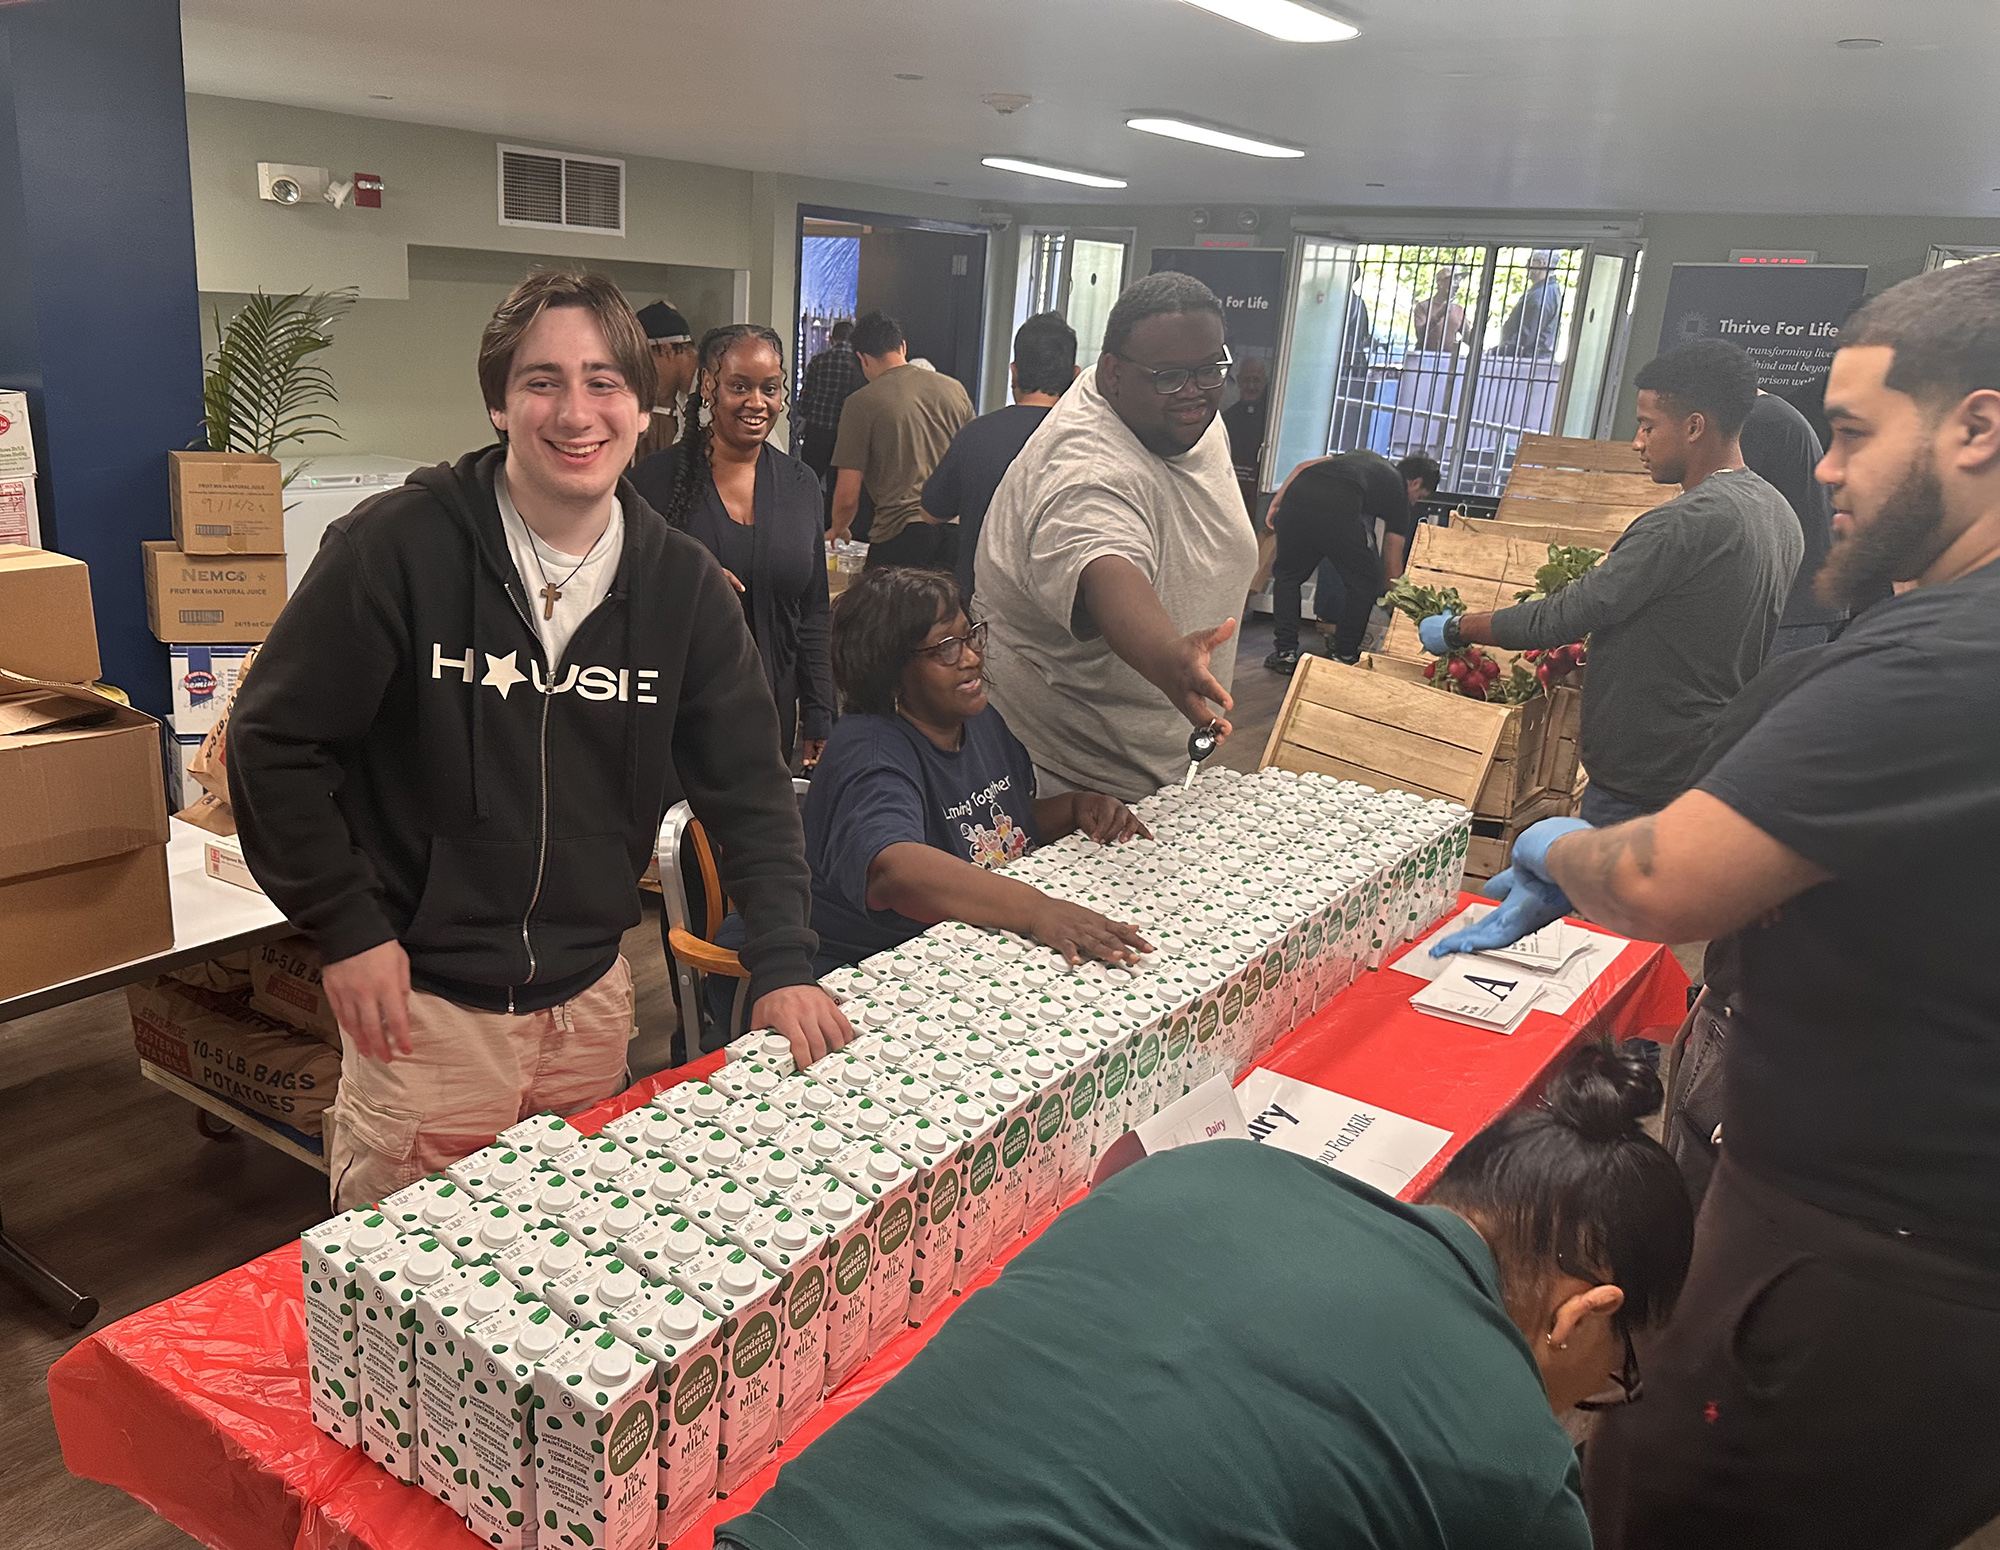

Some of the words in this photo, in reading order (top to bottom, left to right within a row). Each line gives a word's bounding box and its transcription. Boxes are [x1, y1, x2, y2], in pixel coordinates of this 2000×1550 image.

[1226, 296, 1244, 308] For
[1247, 296, 1268, 309] Life
[1719, 319, 1770, 334] Thrive
[1776, 322, 1804, 336] For
[1808, 322, 1839, 337] Life
[1746, 346, 1812, 359] transforming
[1754, 360, 1777, 370] hind
[1779, 361, 1799, 371] and
[1800, 362, 1830, 374] beyon
[1757, 375, 1789, 386] prison
[262, 946, 288, 969] 10-5
[288, 958, 305, 979] LB.
[308, 968, 323, 987] BA
[1463, 974, 1518, 1002] A
[137, 1022, 180, 1057] EASTERN
[164, 1020, 188, 1039] PRIDE
[138, 1040, 188, 1072] OTATOES
[193, 1039, 223, 1064] 10-5
[228, 1050, 250, 1078] LB.
[254, 1063, 316, 1090] BAGS
[204, 1066, 295, 1113] POTATOES
[1206, 1119, 1226, 1137] Dairy
[1341, 1114, 1375, 1137] Milk
[1325, 1134, 1354, 1152] Fat
[1315, 1150, 1337, 1164] ow
[973, 1201, 990, 1223] MILK
[881, 1212, 908, 1238] modern
[884, 1220, 909, 1246] pantry
[933, 1229, 952, 1253] MILK
[838, 1250, 867, 1278] modern
[843, 1257, 868, 1286] pantry
[882, 1258, 905, 1283] MILK
[887, 1252, 899, 1269] 1%
[791, 1282, 820, 1312] modern
[794, 1291, 822, 1319] pantry
[848, 1291, 860, 1308] 1%
[842, 1296, 866, 1324] MILK
[735, 1331, 771, 1360] modern
[794, 1331, 817, 1360] MILK
[799, 1326, 811, 1343] 1%
[740, 1338, 774, 1368] pantry
[677, 1374, 712, 1407] modern
[746, 1374, 761, 1392] 1%
[681, 1382, 714, 1414] pantry
[740, 1381, 769, 1411] MILK
[744, 1397, 764, 1416] LOWFAT
[612, 1420, 648, 1457] modern
[687, 1419, 702, 1439] 1%
[542, 1432, 572, 1447] UNOPENED
[572, 1444, 595, 1459] PACKAGE
[543, 1438, 572, 1452] MAINTAINS
[573, 1449, 594, 1464] QUALITY
[616, 1428, 651, 1464] pantry
[682, 1425, 709, 1459] MILK
[548, 1449, 566, 1459] STORE
[574, 1459, 590, 1471] ROOM
[550, 1455, 587, 1475] TEMPERATURE
[548, 1469, 565, 1480] AFTER
[566, 1477, 589, 1491] OPENING
[551, 1465, 586, 1484] REFRIGERATE
[624, 1468, 639, 1490] 1%
[544, 1477, 574, 1494] SUGGESTED
[575, 1490, 592, 1502] USAGE
[548, 1484, 568, 1496] WITHIN
[575, 1496, 588, 1505] DAYS
[560, 1494, 584, 1508] OPENING
[618, 1473, 647, 1511] MILK
[556, 1501, 574, 1513] GRADE
[622, 1492, 643, 1515] LOWFAT
